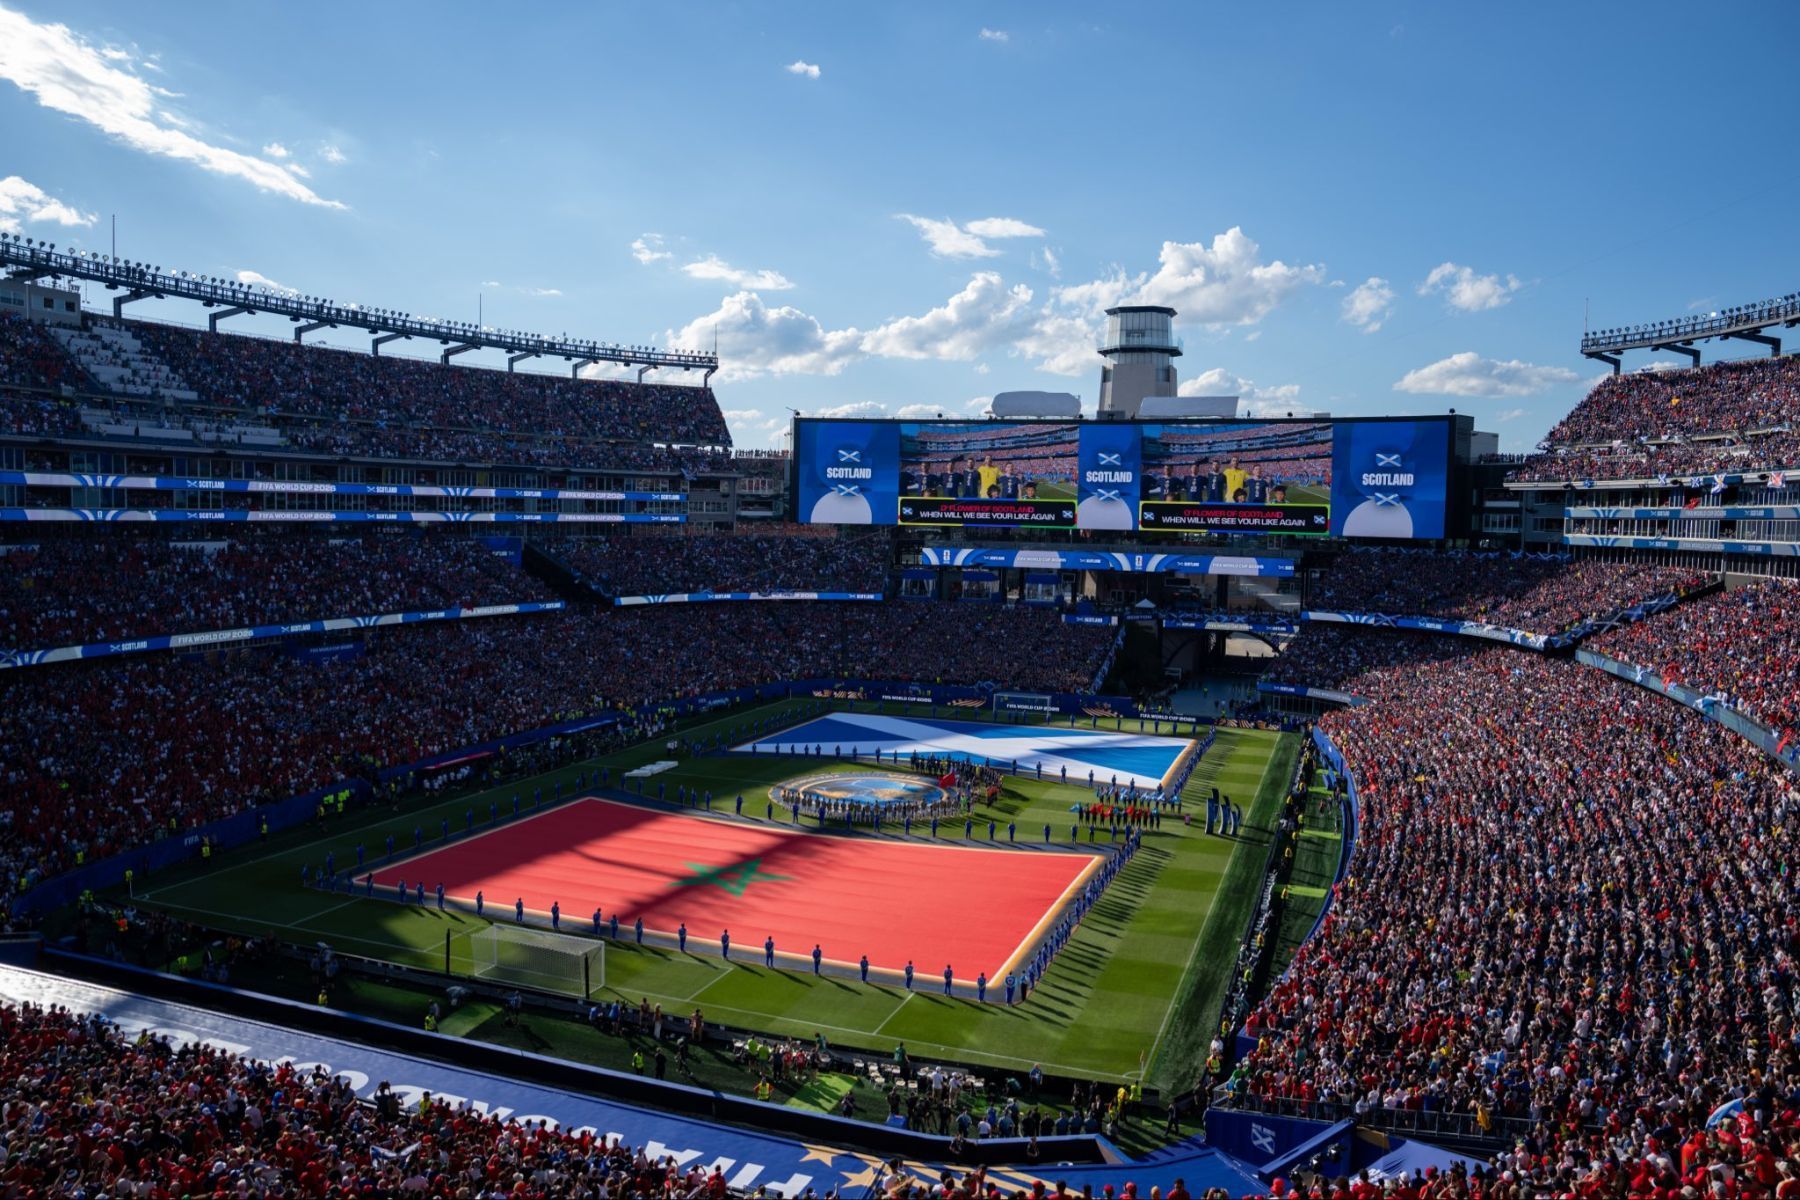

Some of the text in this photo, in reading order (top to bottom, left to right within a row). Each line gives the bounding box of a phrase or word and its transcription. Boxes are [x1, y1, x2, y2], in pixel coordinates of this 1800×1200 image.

[827, 467, 872, 479] SCOTLAND
[1086, 471, 1132, 482] SCOTLAND
[199, 481, 224, 489] SCOTLAND
[1362, 474, 1414, 486] SCOTLAND
[290, 624, 310, 632] SCOTLAND
[178, 636, 194, 644] FIFA
[194, 632, 217, 643] WORLD
[219, 631, 232, 640] CUP
[122, 641, 148, 652] SCOTLAND
[184, 834, 200, 848] FIFA
